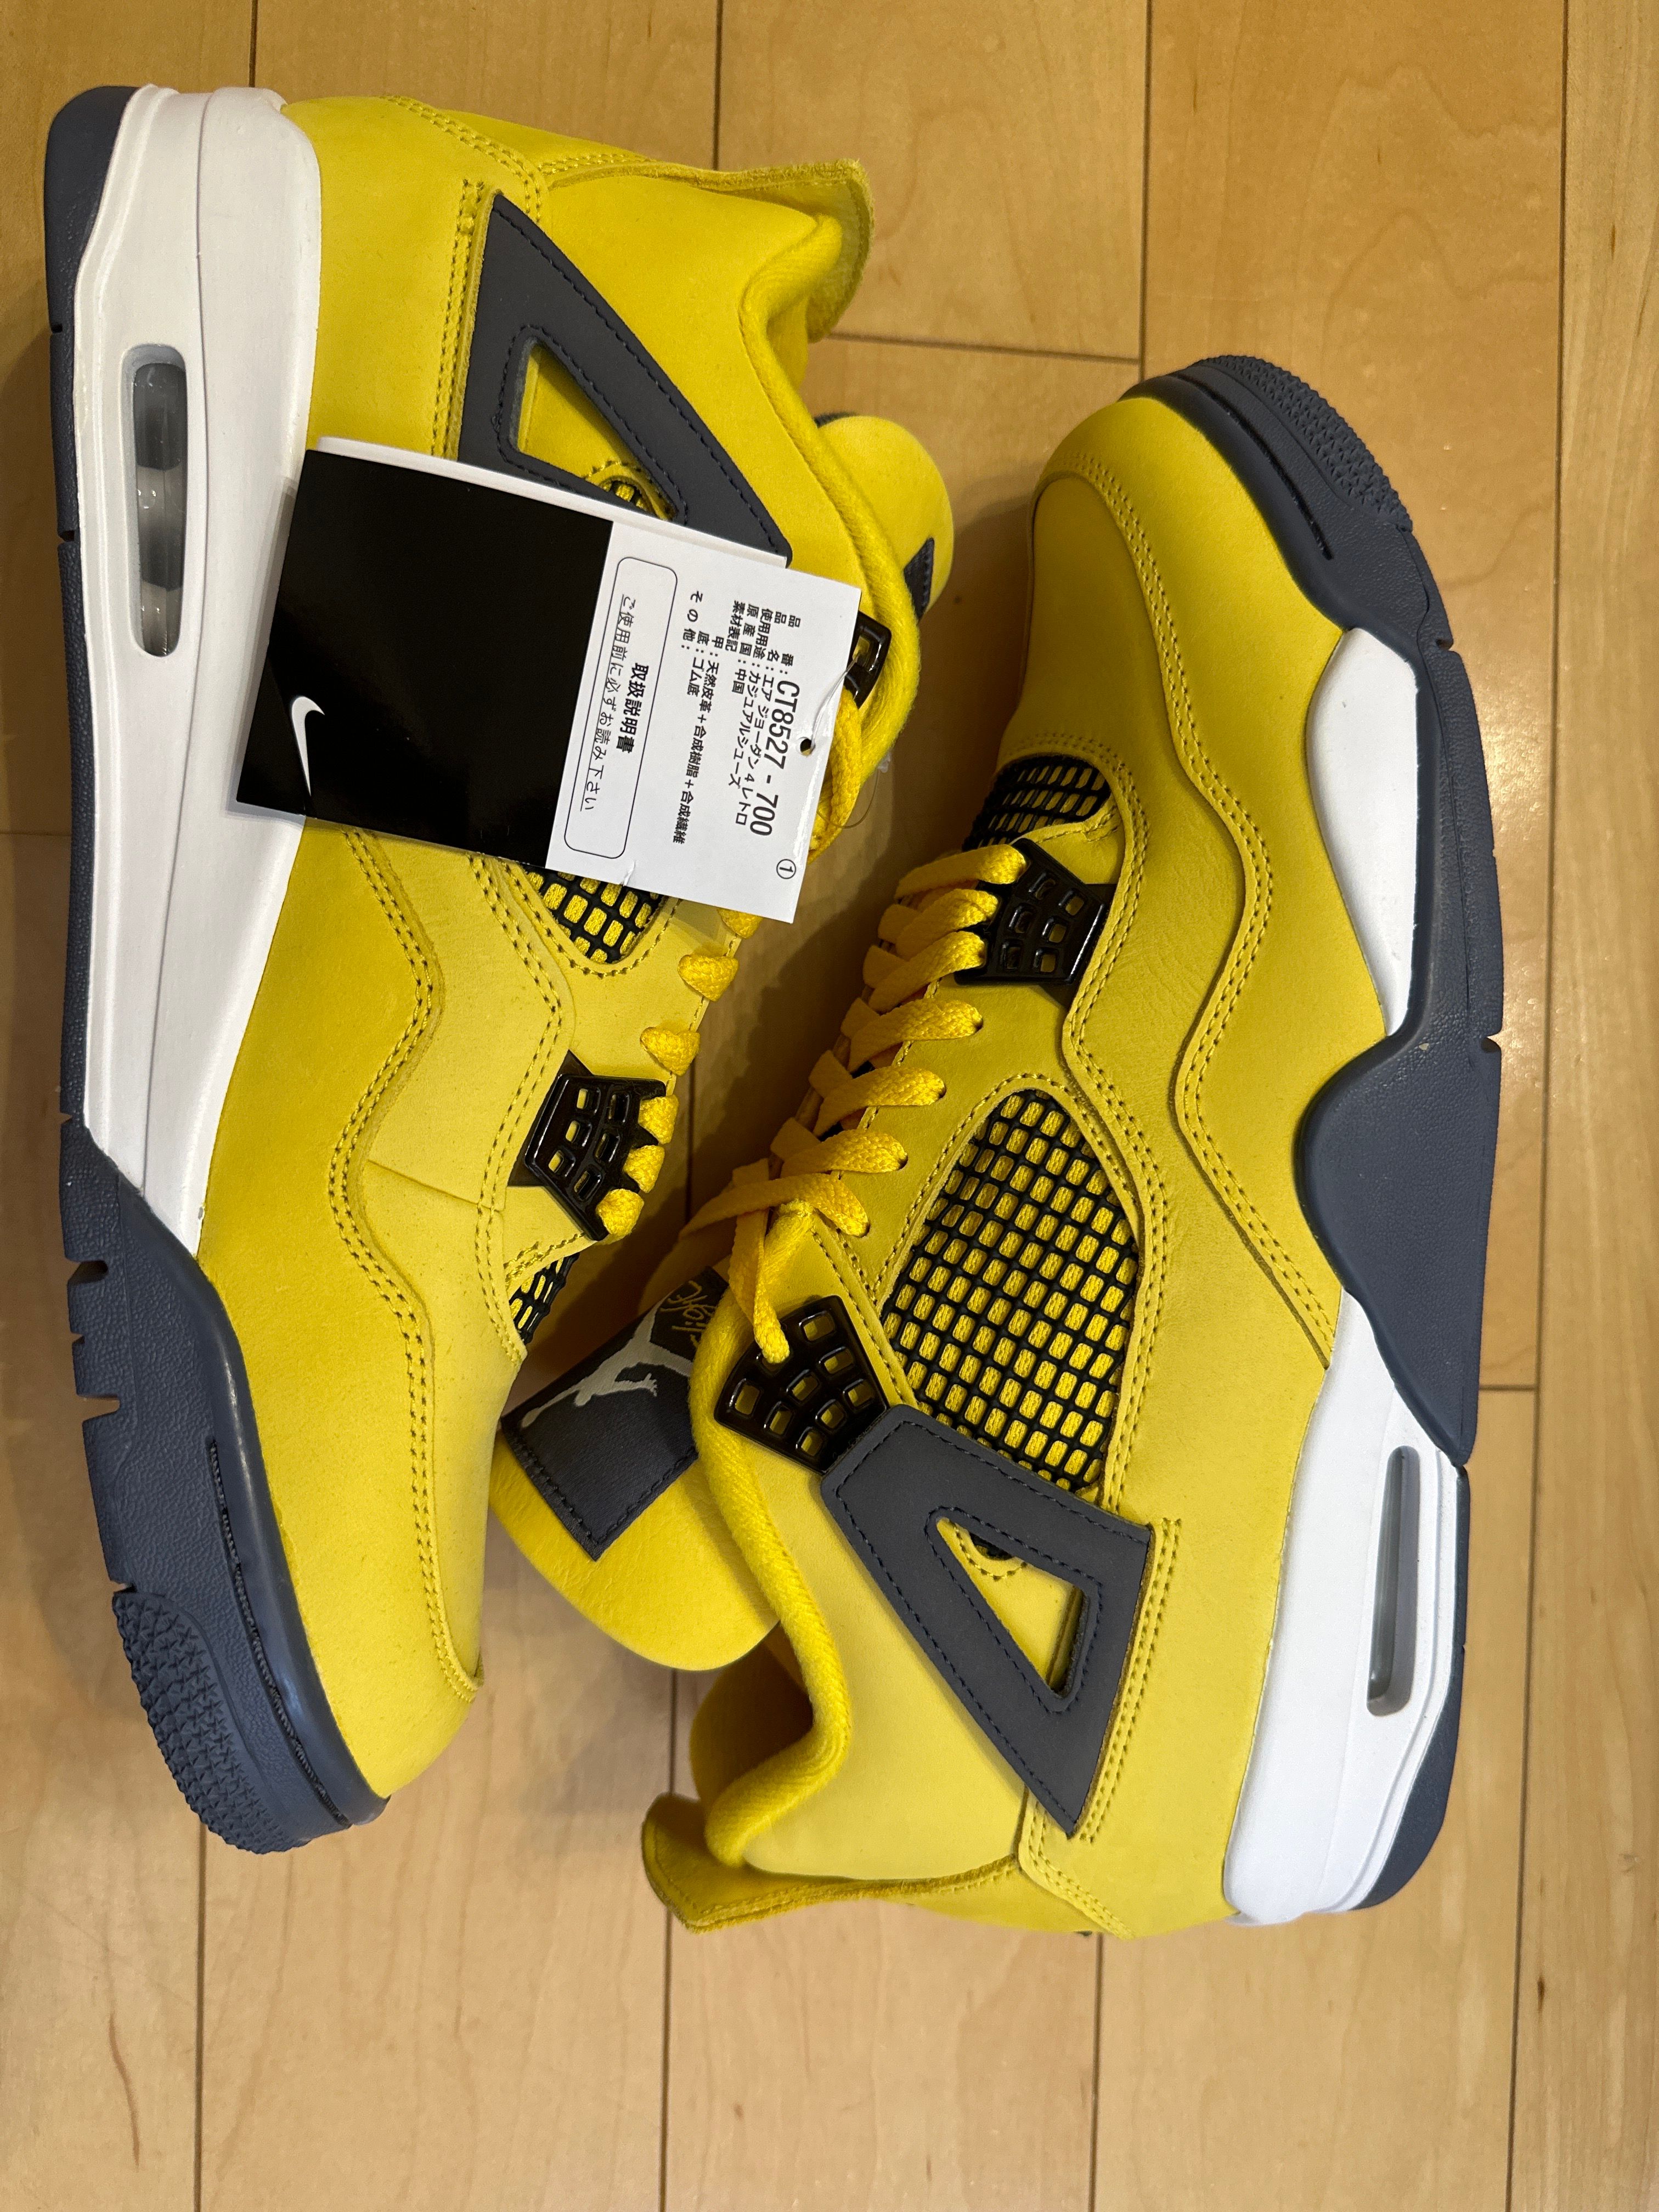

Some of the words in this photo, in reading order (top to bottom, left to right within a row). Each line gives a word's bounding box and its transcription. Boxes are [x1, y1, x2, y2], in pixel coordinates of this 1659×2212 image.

[725, 600, 746, 653] 素材表記
[580, 594, 636, 812] ご使用前に必ずお読み下さい
[616, 662, 650, 754] 取扱説明書
[763, 680, 800, 770] CT8527
[744, 773, 755, 782] 4
[735, 787, 754, 826] レトロ
[749, 792, 779, 836] 700
